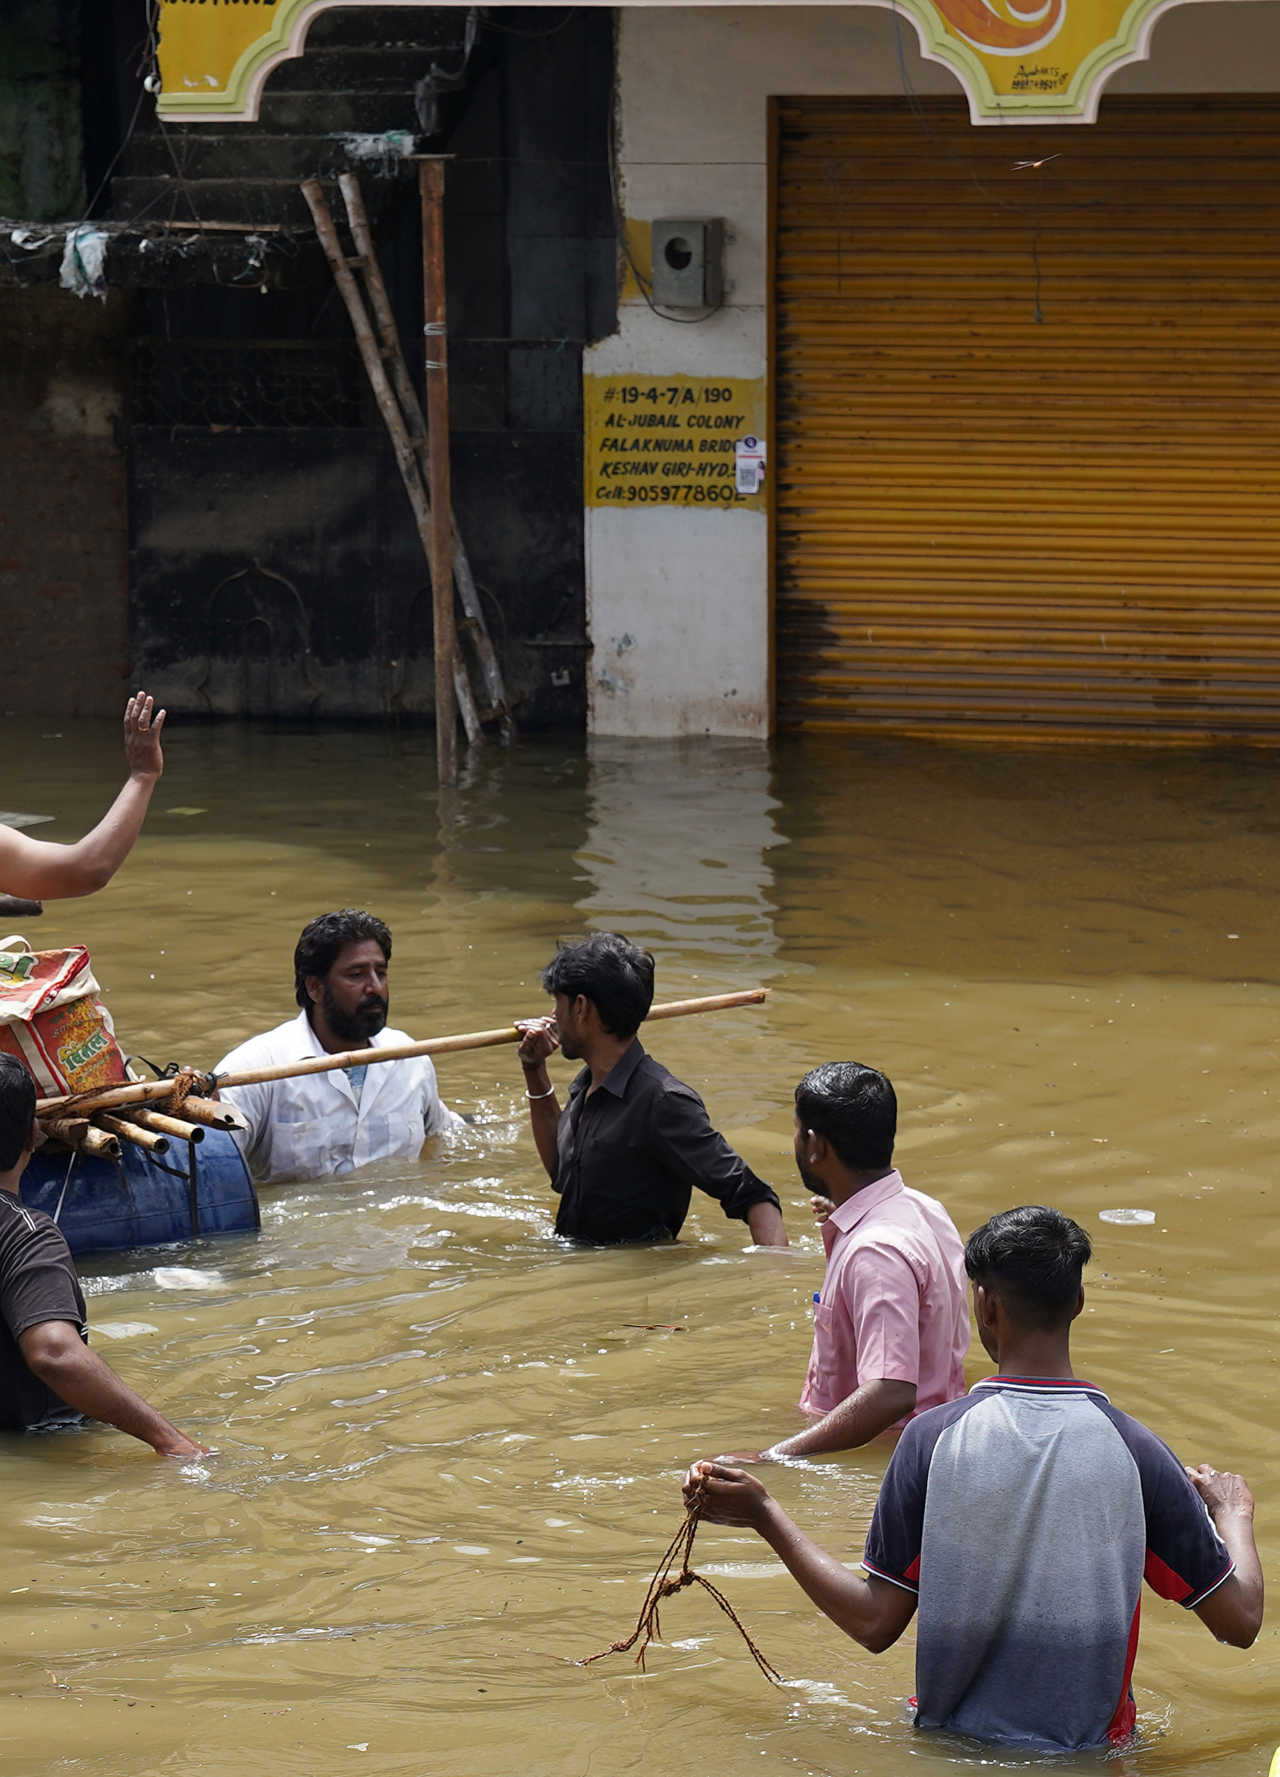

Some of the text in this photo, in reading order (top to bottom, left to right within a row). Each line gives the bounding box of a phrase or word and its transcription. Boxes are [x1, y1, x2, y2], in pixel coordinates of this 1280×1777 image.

[686, 414, 746, 429] COLONY
[600, 437, 694, 453] FALAKNUMA
[600, 462, 658, 479] KESHAV
